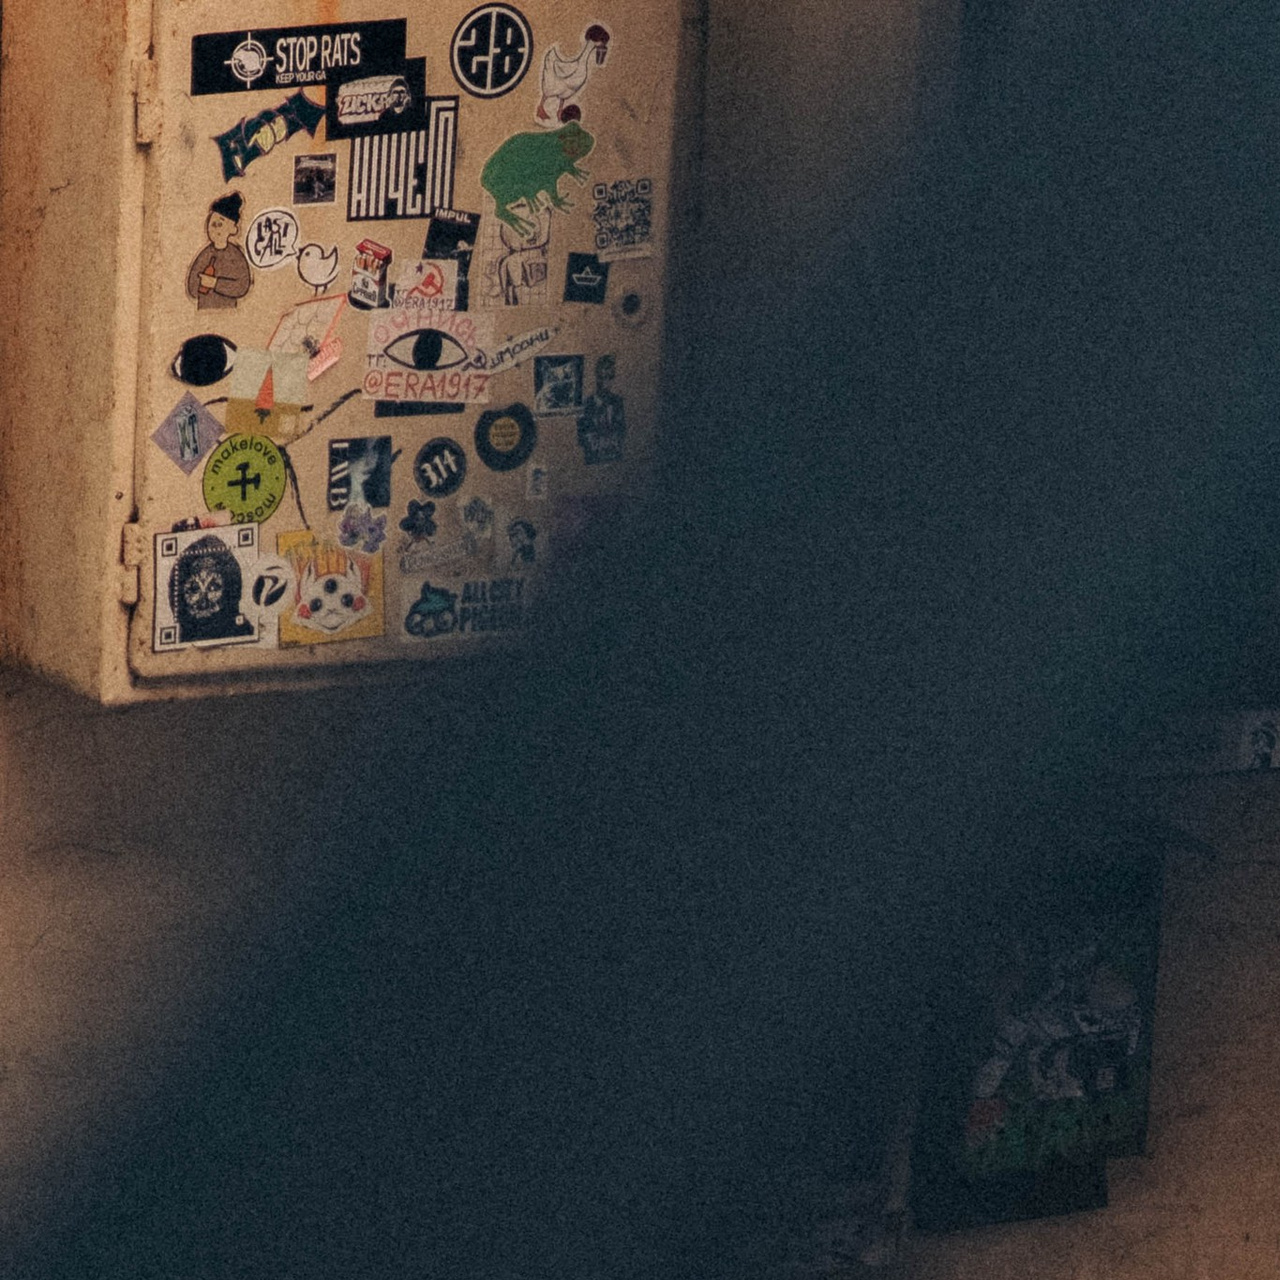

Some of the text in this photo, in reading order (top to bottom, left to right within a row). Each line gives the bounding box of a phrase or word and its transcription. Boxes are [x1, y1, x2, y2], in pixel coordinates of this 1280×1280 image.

[275, 32, 361, 73] STOP RATS
[275, 74, 294, 84] KEEP
[295, 71, 315, 82] YOUR
[364, 370, 490, 399] @ERA1917
[211, 437, 277, 475] makelove
[420, 449, 458, 489] 3.14
